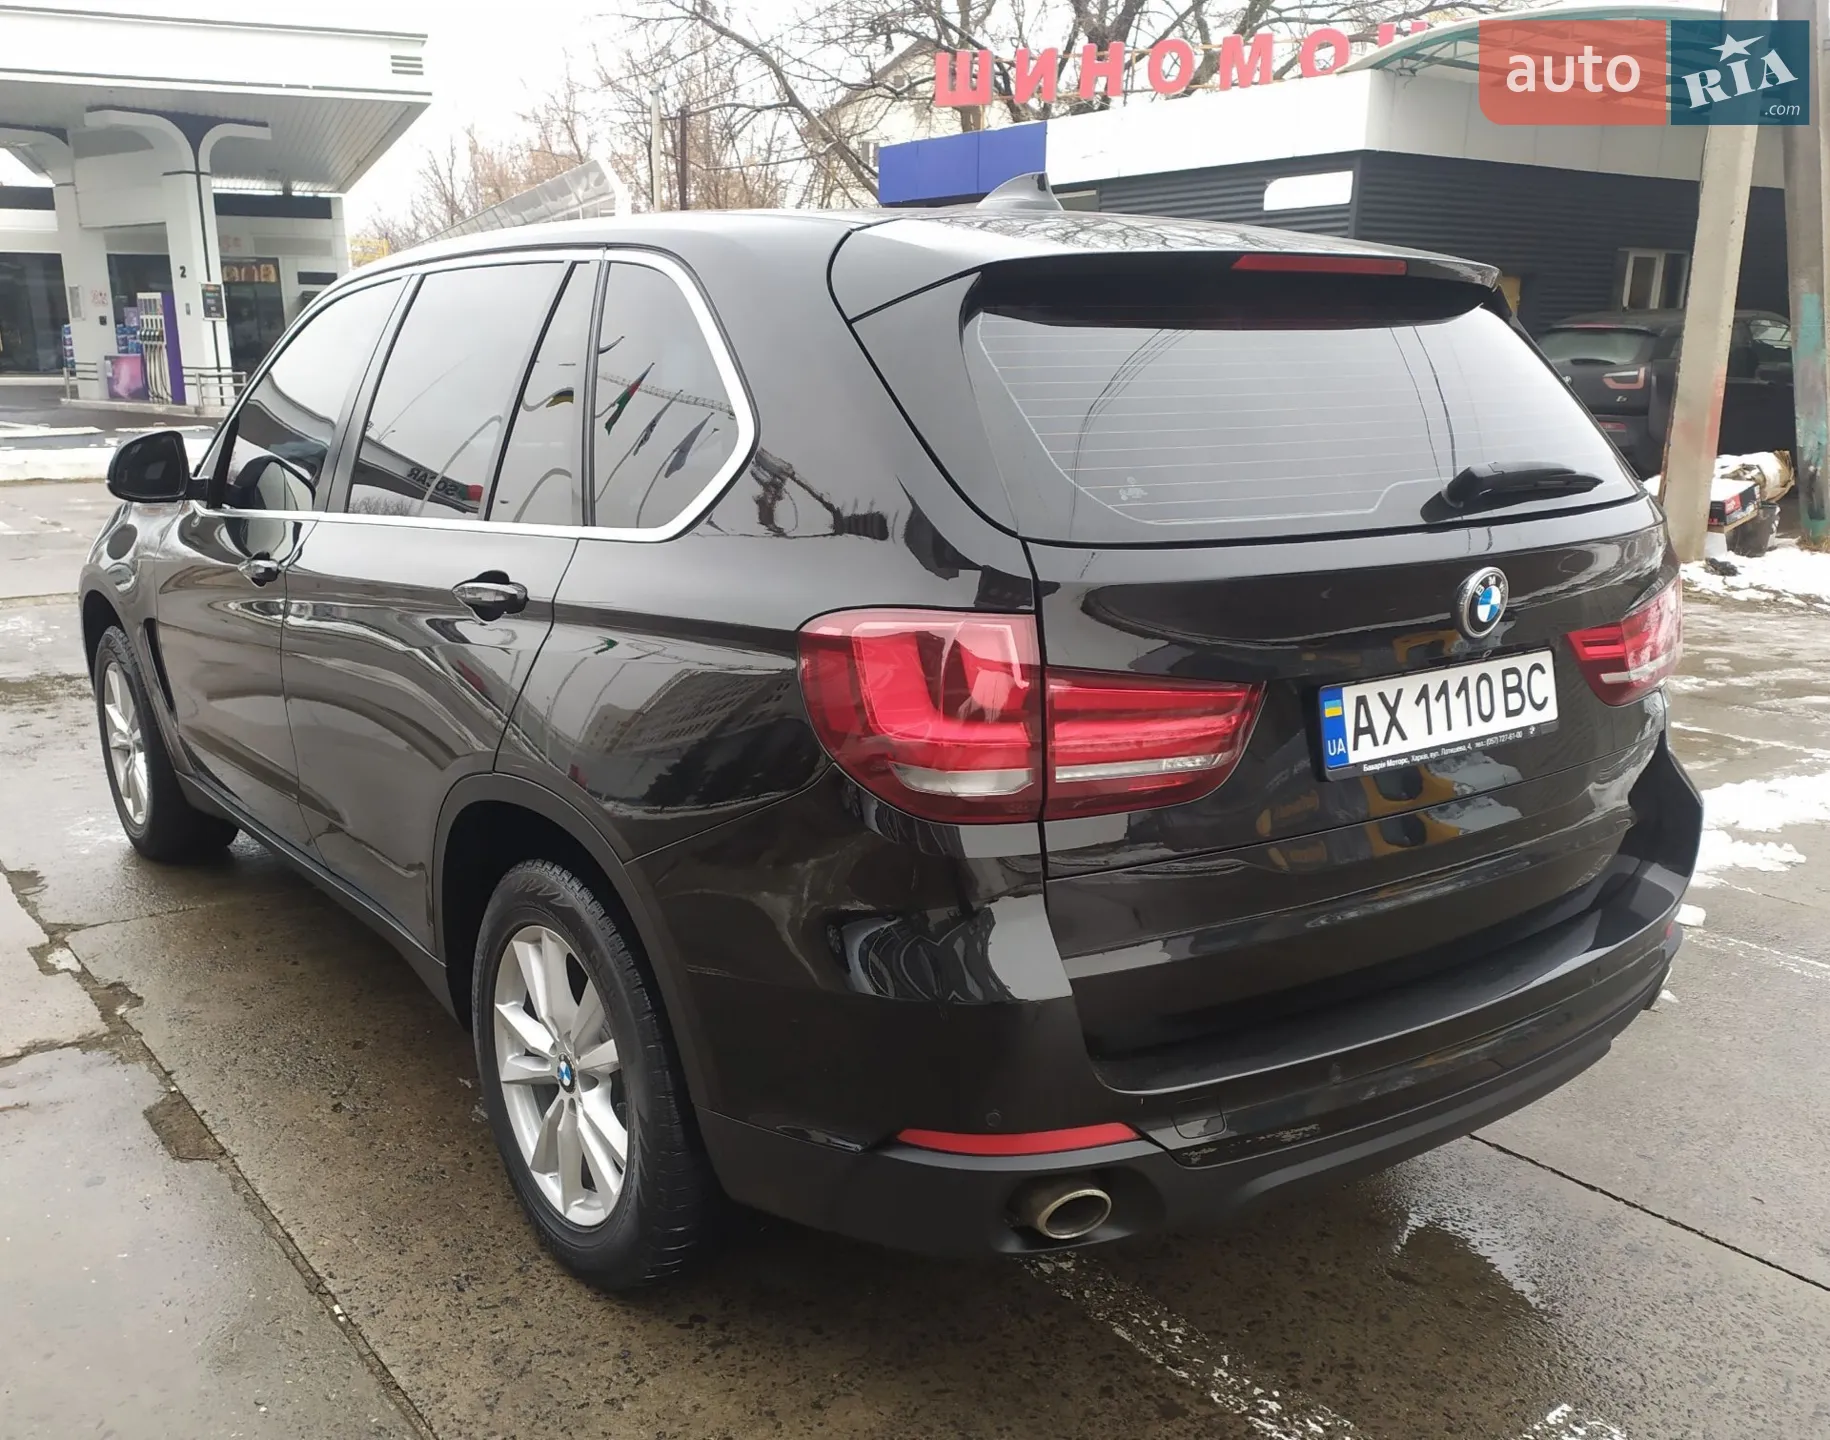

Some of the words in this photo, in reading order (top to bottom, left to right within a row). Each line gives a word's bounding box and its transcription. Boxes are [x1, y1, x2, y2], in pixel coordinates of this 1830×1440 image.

[179, 265, 187, 279] 2
[1353, 687, 1409, 752] AX
[1414, 672, 1496, 736] 1110
[1501, 662, 1550, 719] BC
[1327, 738, 1347, 757] UA
